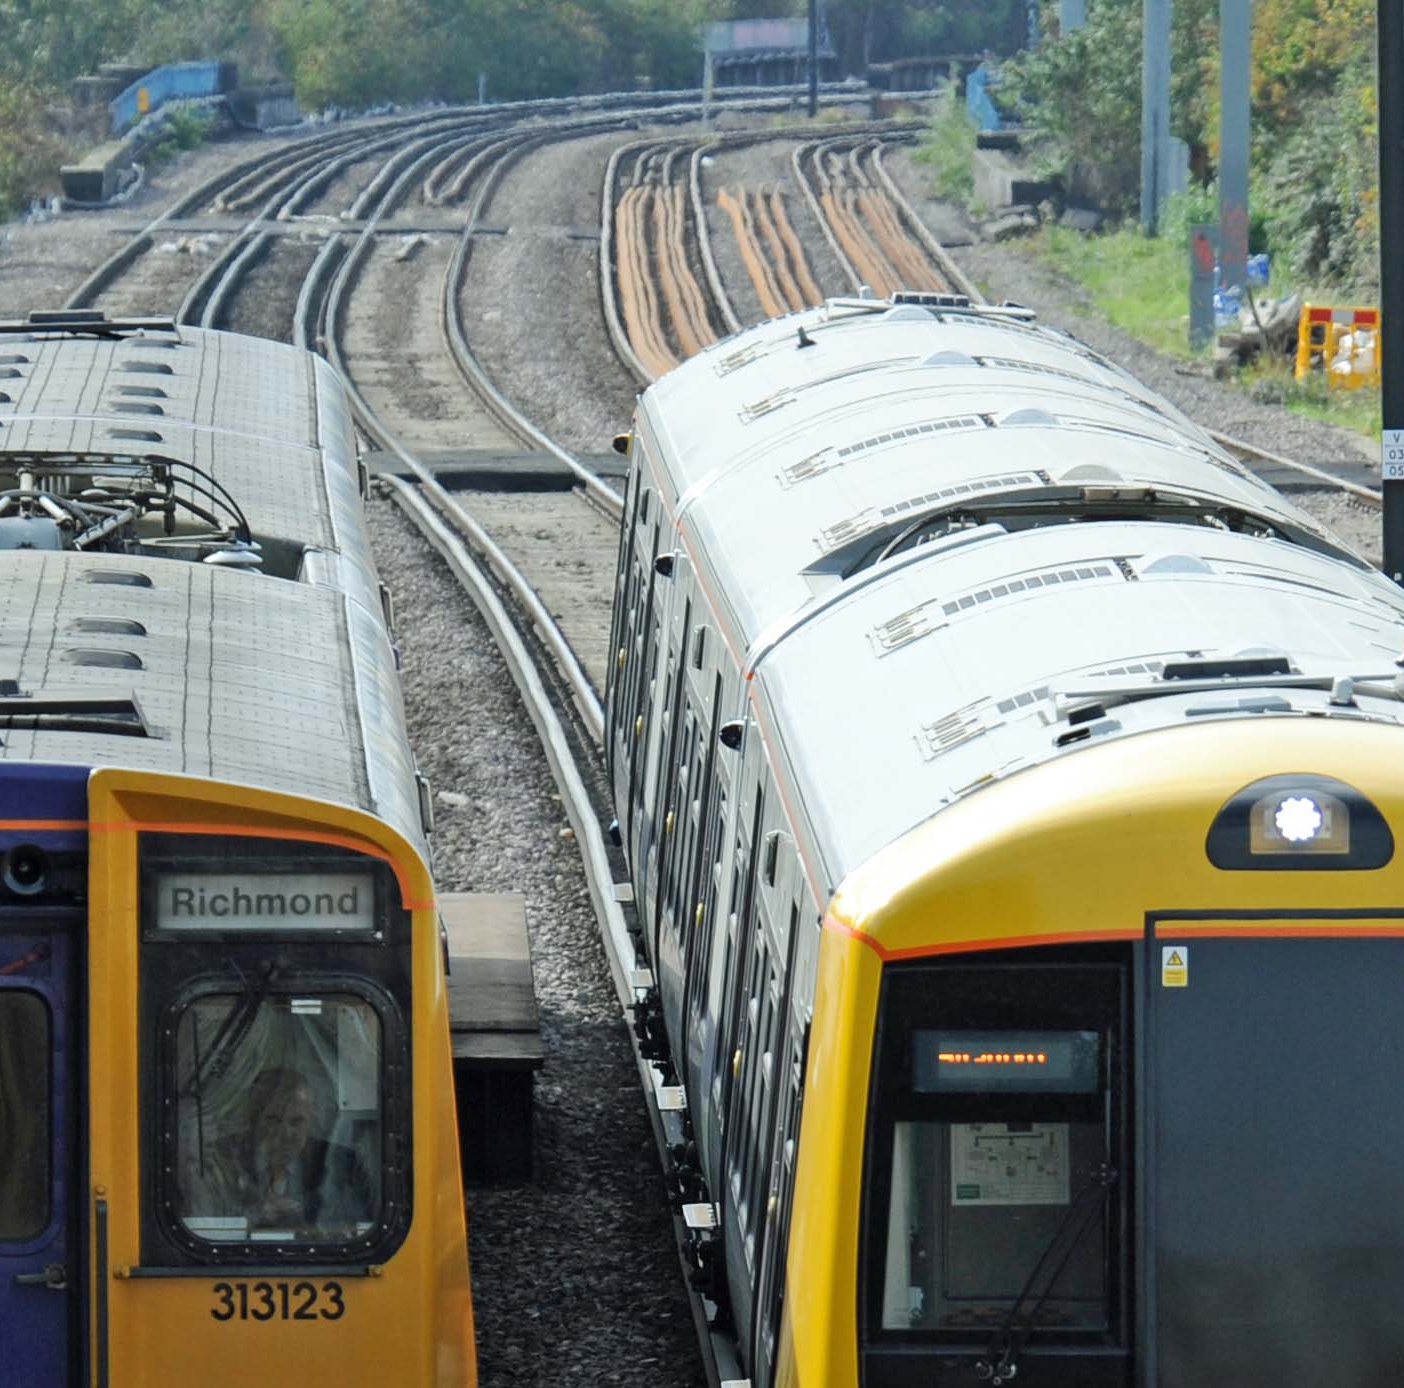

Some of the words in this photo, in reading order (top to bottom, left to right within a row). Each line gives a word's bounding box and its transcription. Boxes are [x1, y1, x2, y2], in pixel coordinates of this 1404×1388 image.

[1392, 432, 1401, 443] V
[1389, 449, 1404, 460] 03
[1389, 465, 1404, 476] 05
[171, 886, 359, 917] Richmond
[210, 1281, 345, 1321] 313123
